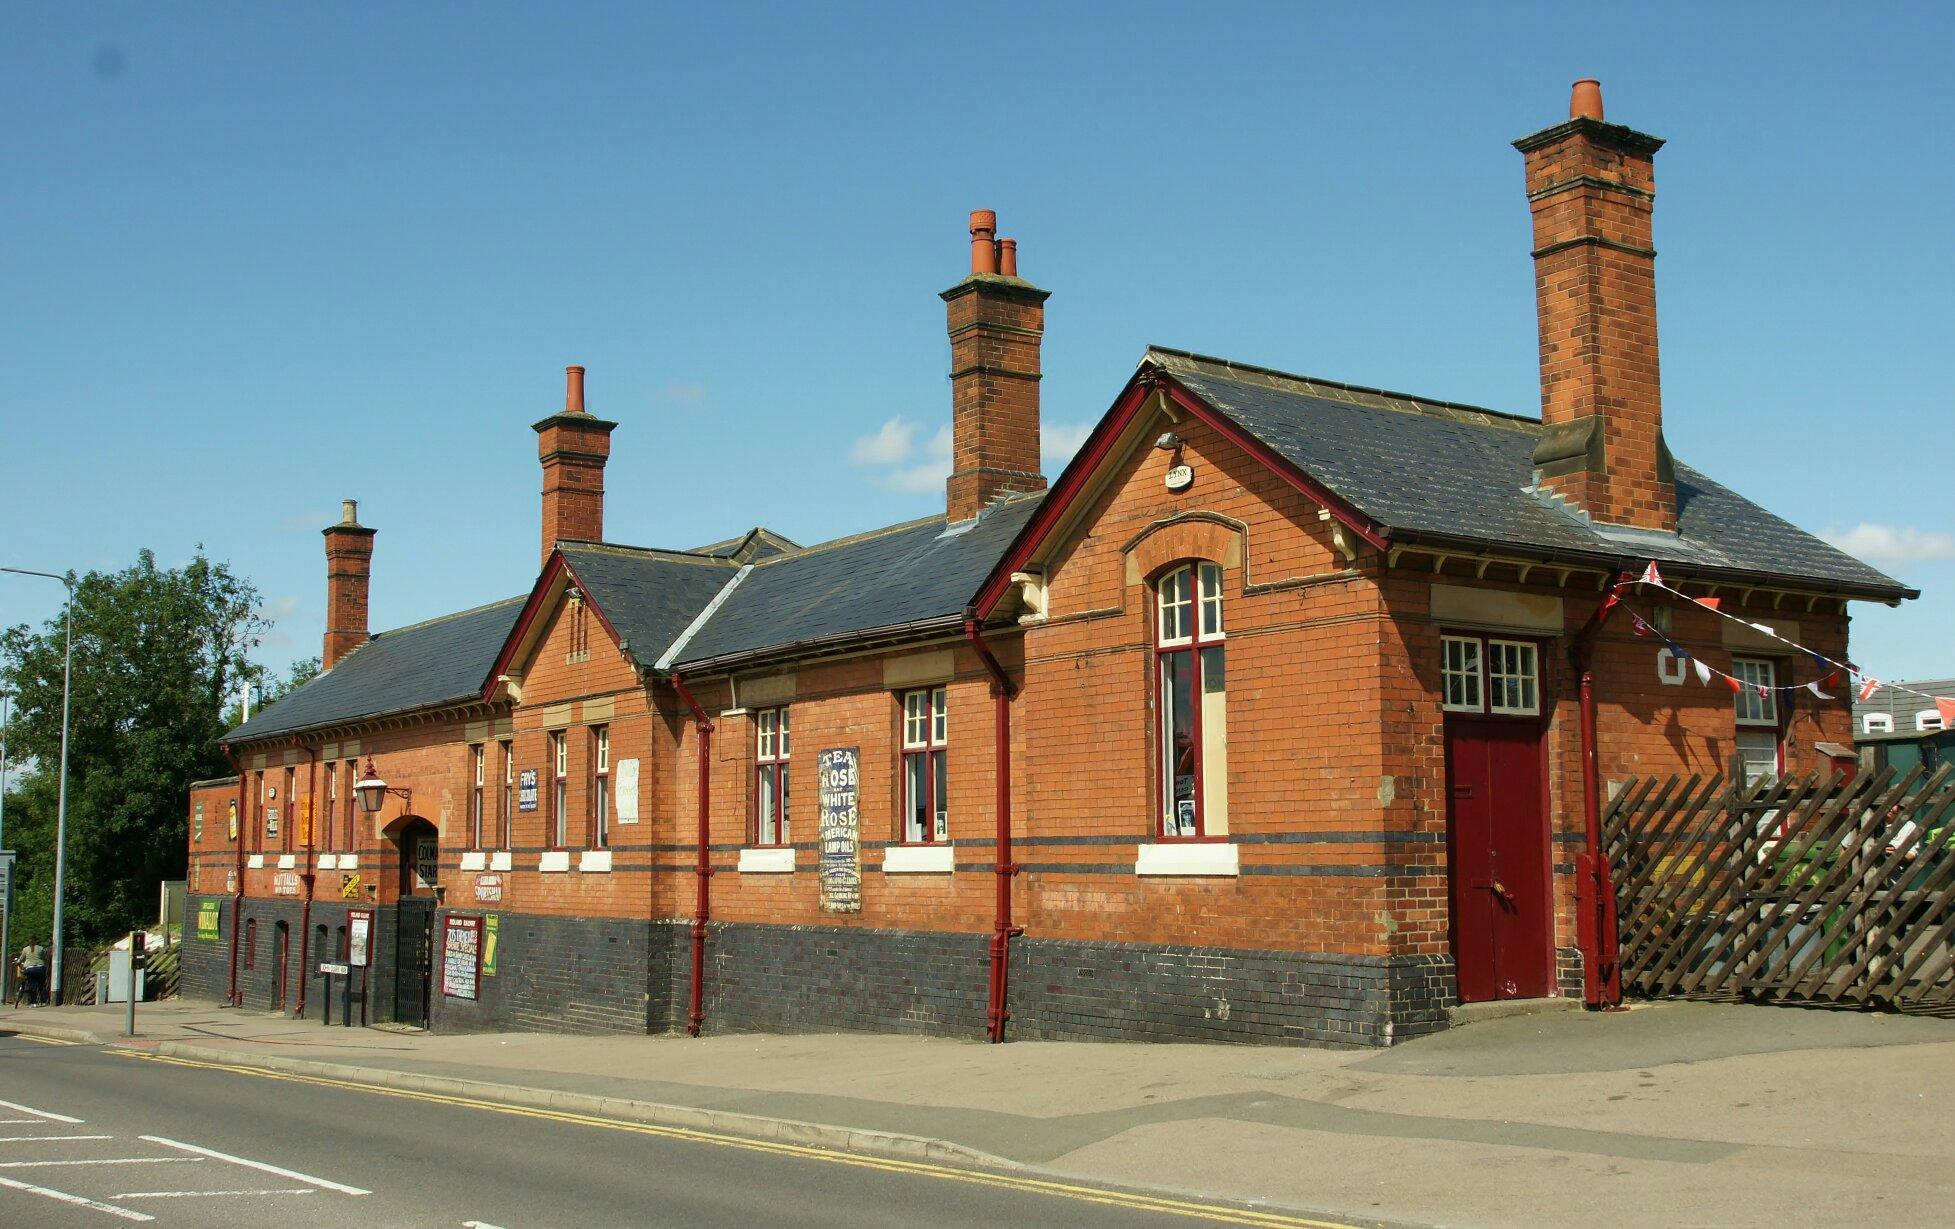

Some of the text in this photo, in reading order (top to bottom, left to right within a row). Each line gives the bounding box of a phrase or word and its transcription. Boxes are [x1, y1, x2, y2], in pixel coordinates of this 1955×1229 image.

[1168, 468, 1187, 480] LYNX
[822, 750, 853, 767] TEA
[822, 768, 856, 788] ROSE
[822, 791, 856, 807] WHITE
[820, 807, 858, 827] ROSE
[825, 841, 840, 853] LAMP
